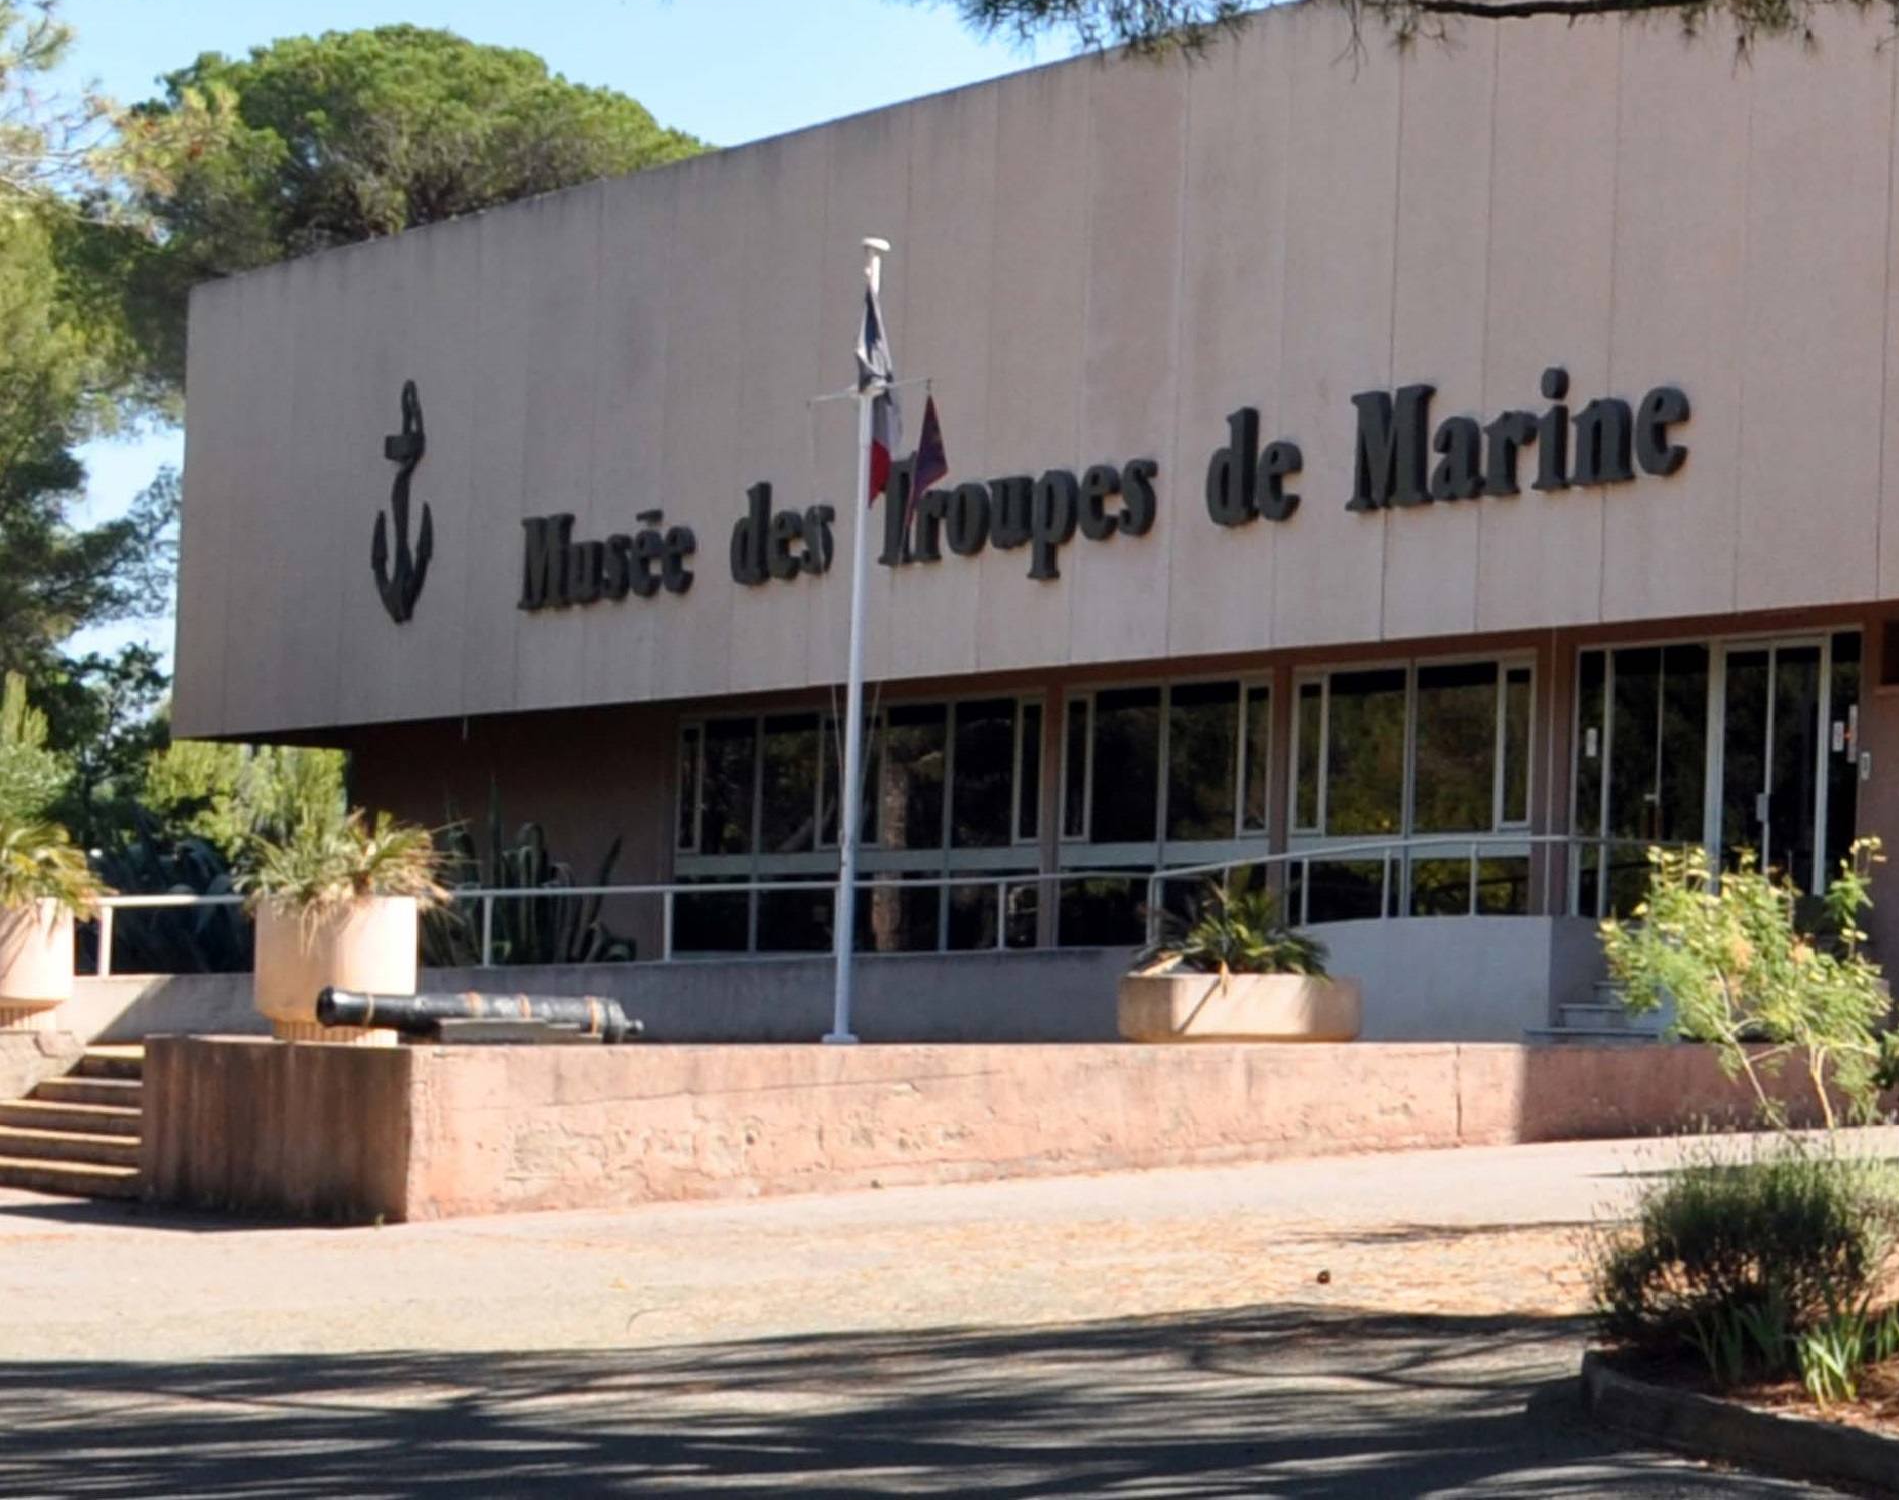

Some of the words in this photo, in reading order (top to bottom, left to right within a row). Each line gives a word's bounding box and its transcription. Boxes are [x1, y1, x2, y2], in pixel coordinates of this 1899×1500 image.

[730, 481, 836, 588] des
[1206, 407, 1304, 529] de
[1345, 366, 1691, 514] Marine
